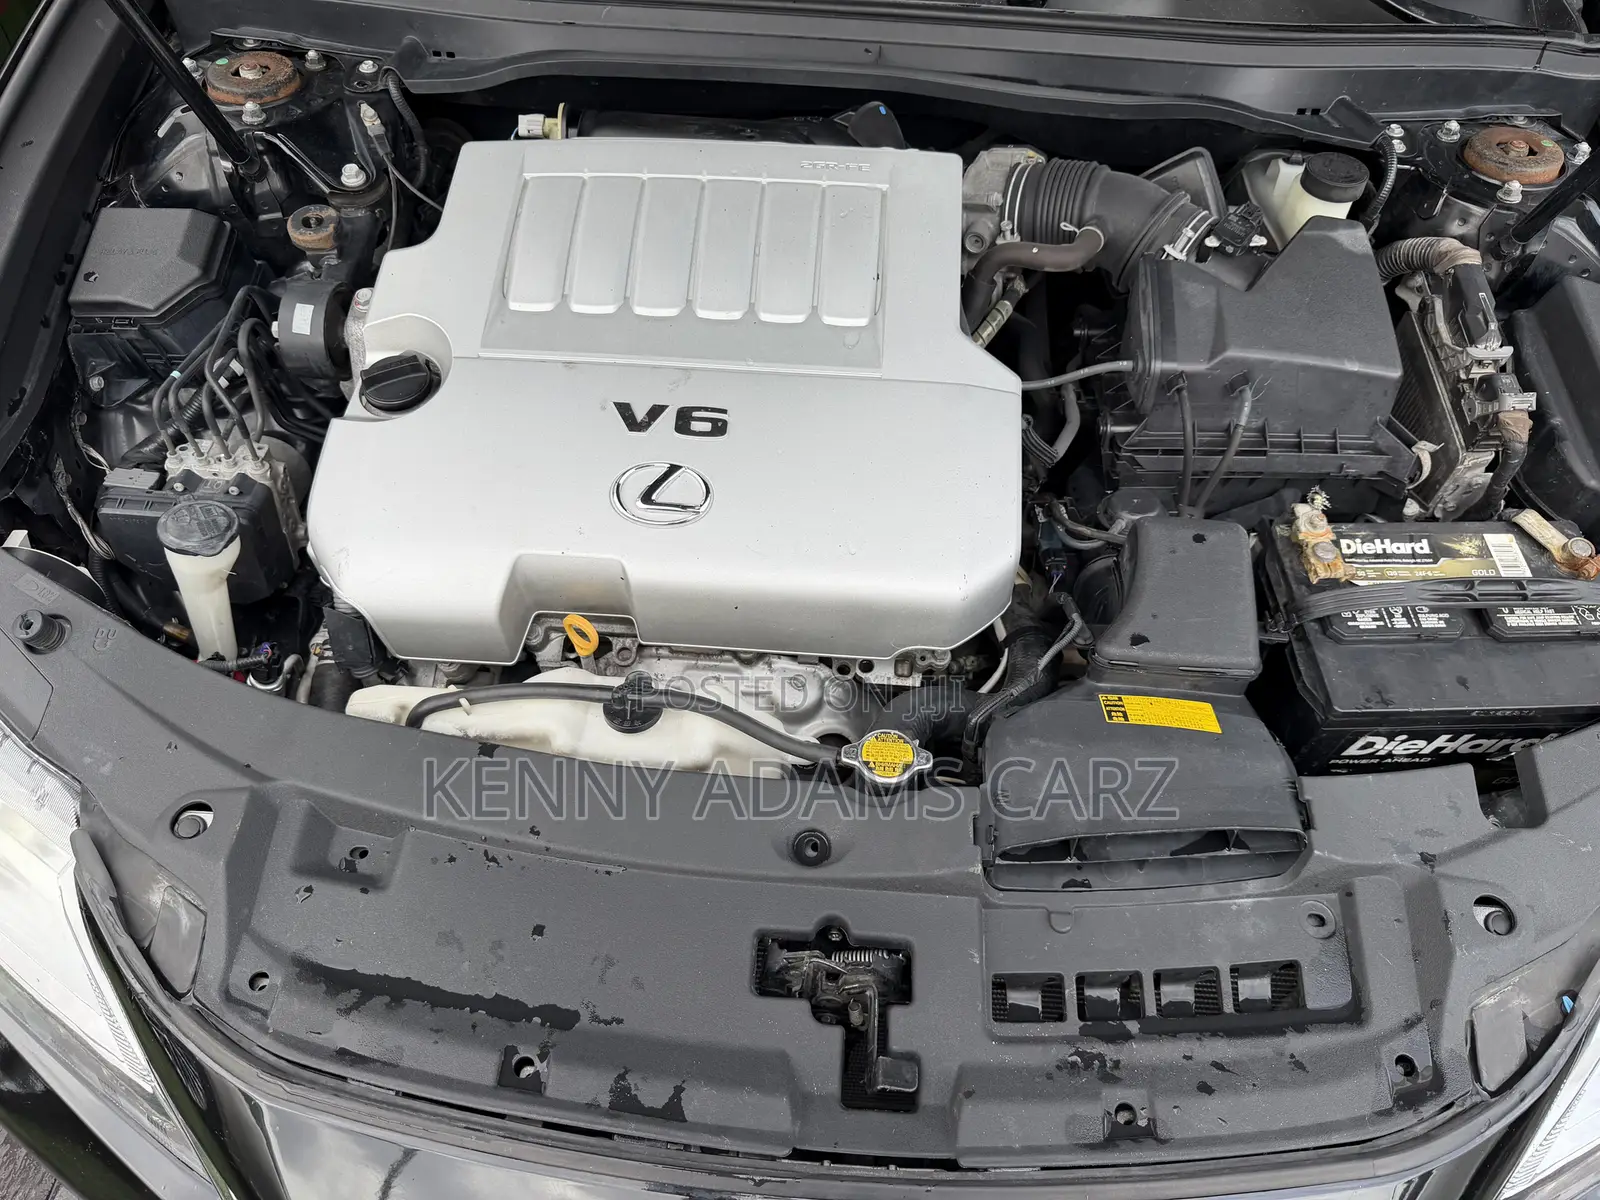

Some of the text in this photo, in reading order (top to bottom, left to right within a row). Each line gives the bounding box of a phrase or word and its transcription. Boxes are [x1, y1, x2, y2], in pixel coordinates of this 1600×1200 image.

[611, 400, 729, 438] V6
[1339, 538, 1431, 555] DieHard
[1471, 568, 1496, 576] GOLD
